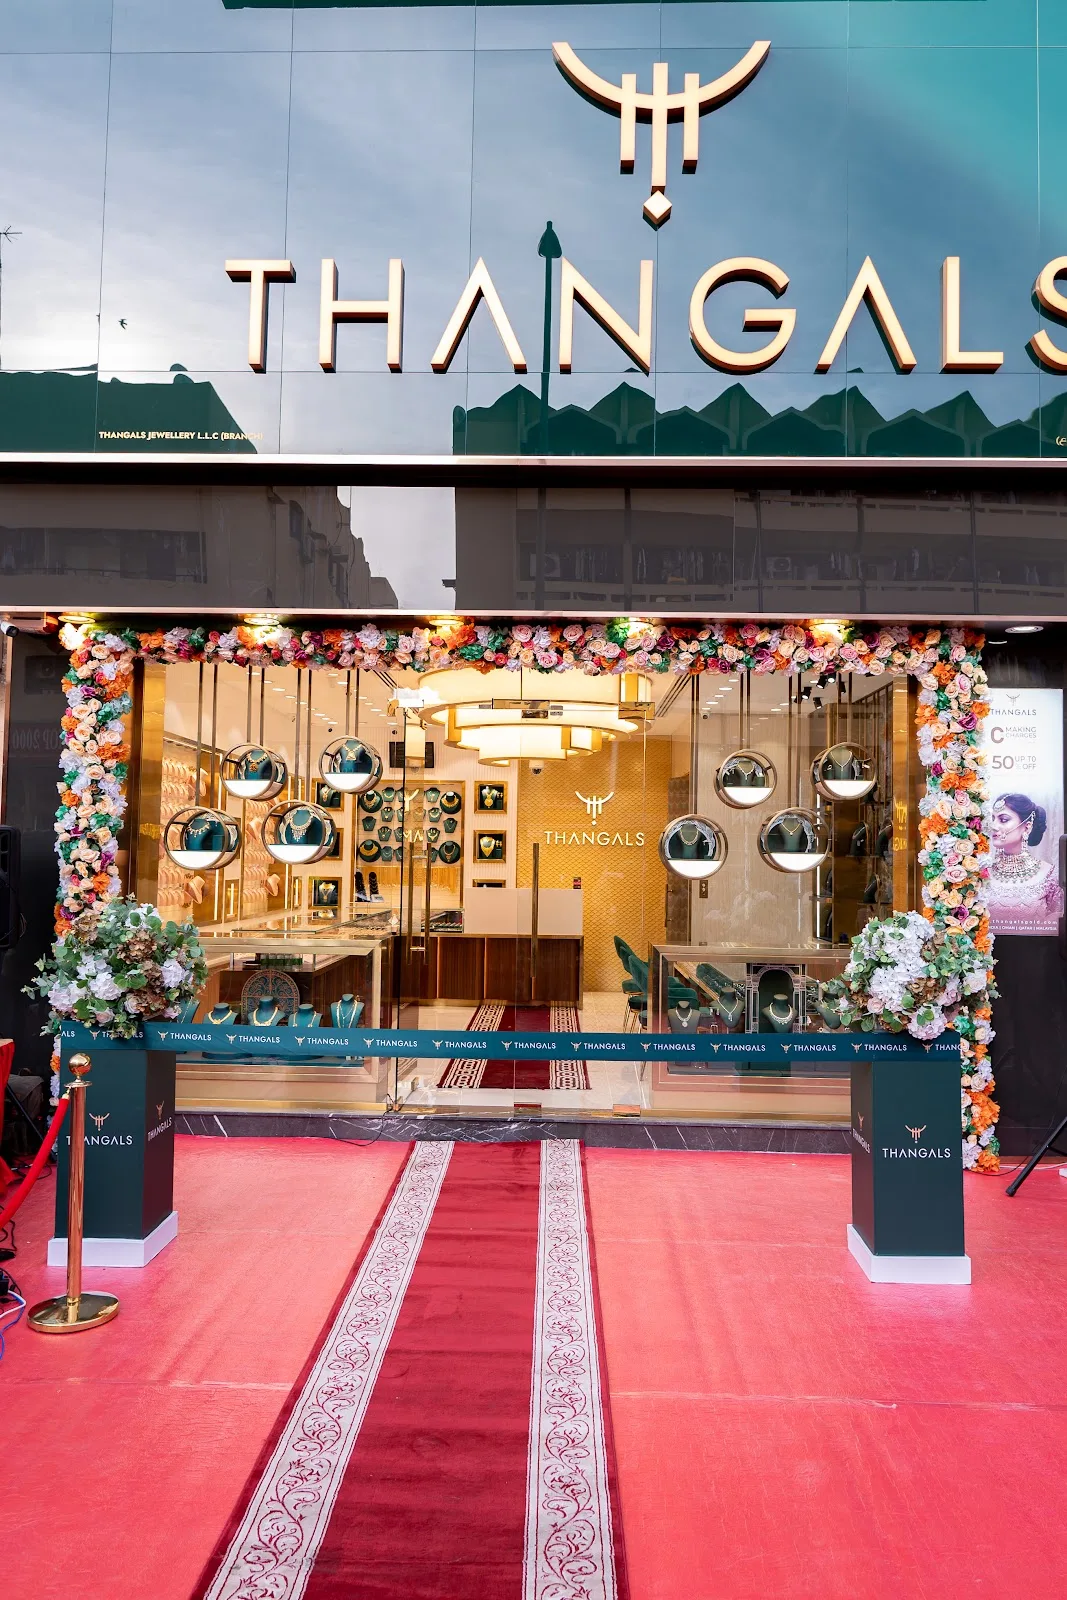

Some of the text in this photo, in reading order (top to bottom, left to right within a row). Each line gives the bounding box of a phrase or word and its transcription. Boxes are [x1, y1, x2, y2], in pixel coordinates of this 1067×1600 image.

[99, 431, 264, 441] THANGALS JEWELLERY L.L.C (BRANCH)
[990, 708, 1037, 716] THANGALS
[991, 755, 1015, 770] 50
[544, 831, 645, 846] THANGALS
[171, 1032, 212, 1041] THANGALS
[238, 1035, 281, 1043] THANGALS
[306, 1037, 349, 1045] THANGALS
[375, 1039, 419, 1047] THANGALS
[514, 1042, 556, 1050] THANGALS
[583, 1042, 626, 1050] THANGALS
[722, 1044, 767, 1052] THANGALS
[792, 1044, 837, 1052] THANGALS
[865, 1044, 908, 1052] THANGALS
[147, 1117, 173, 1142] THANGALS
[66, 1135, 133, 1146] TANGALS
[882, 1148, 951, 1158] THANGALS
